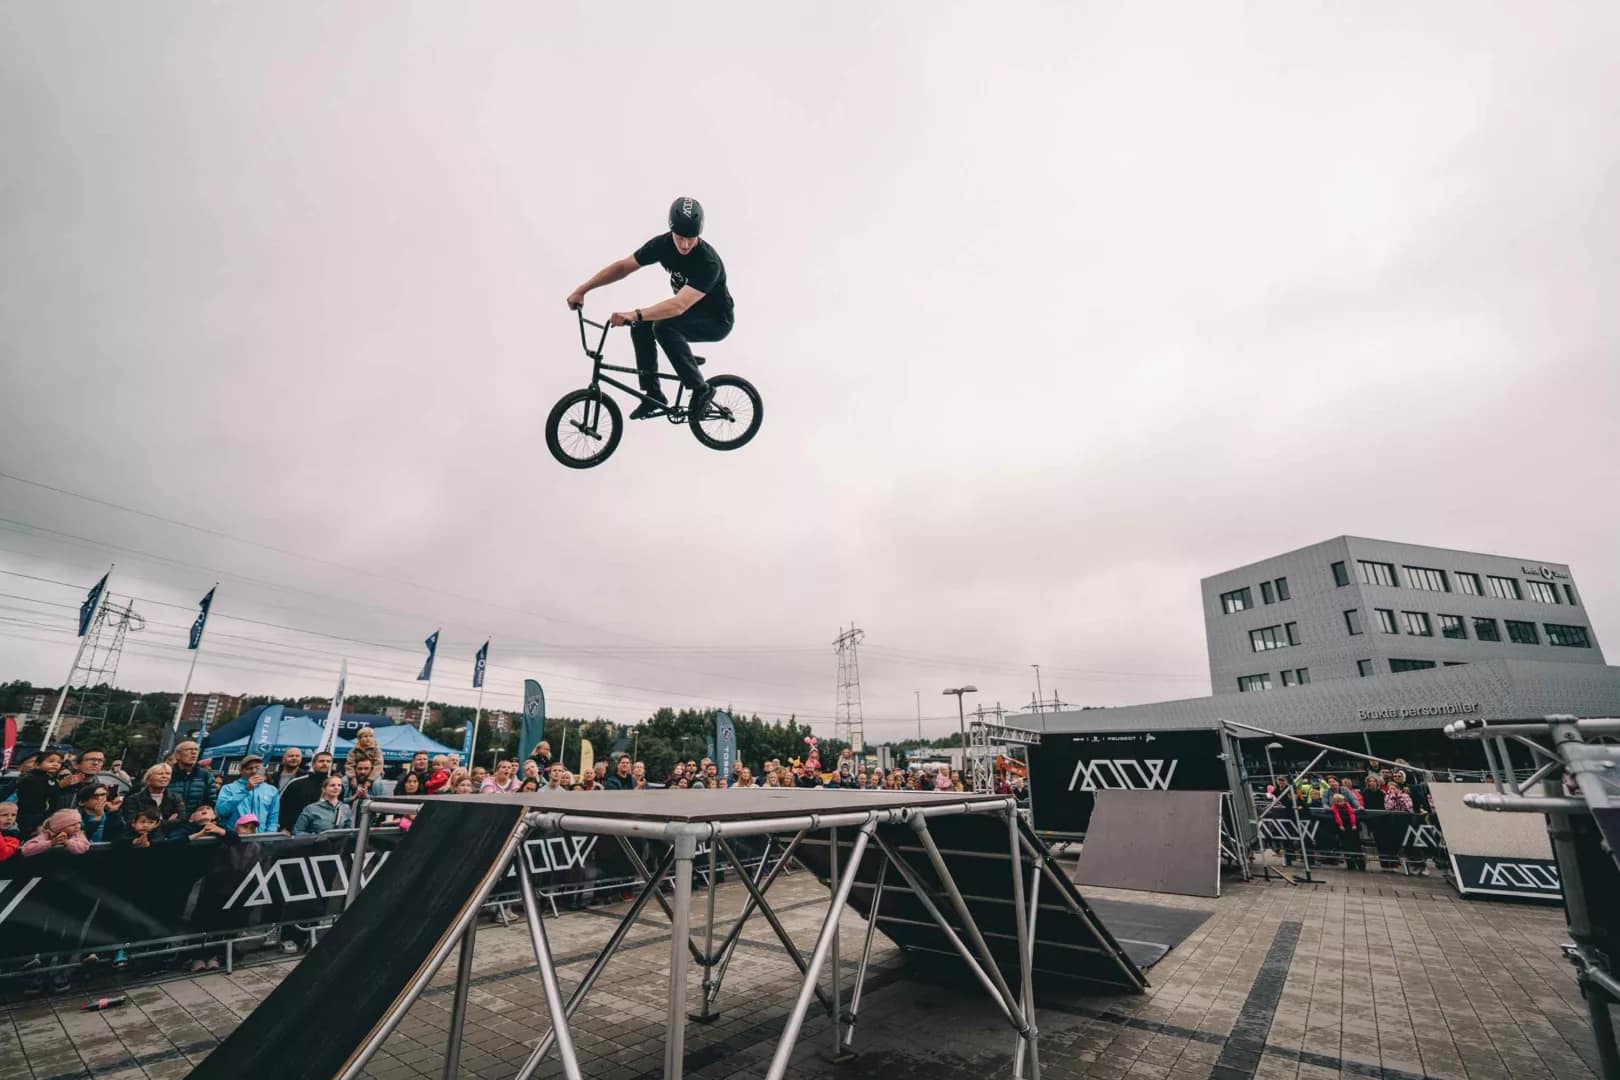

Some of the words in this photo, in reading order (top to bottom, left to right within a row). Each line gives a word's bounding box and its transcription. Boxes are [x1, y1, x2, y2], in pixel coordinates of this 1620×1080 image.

[1359, 709, 1397, 720] Brukte
[1400, 702, 1479, 719] personbiler
[507, 835, 599, 877] OOW
